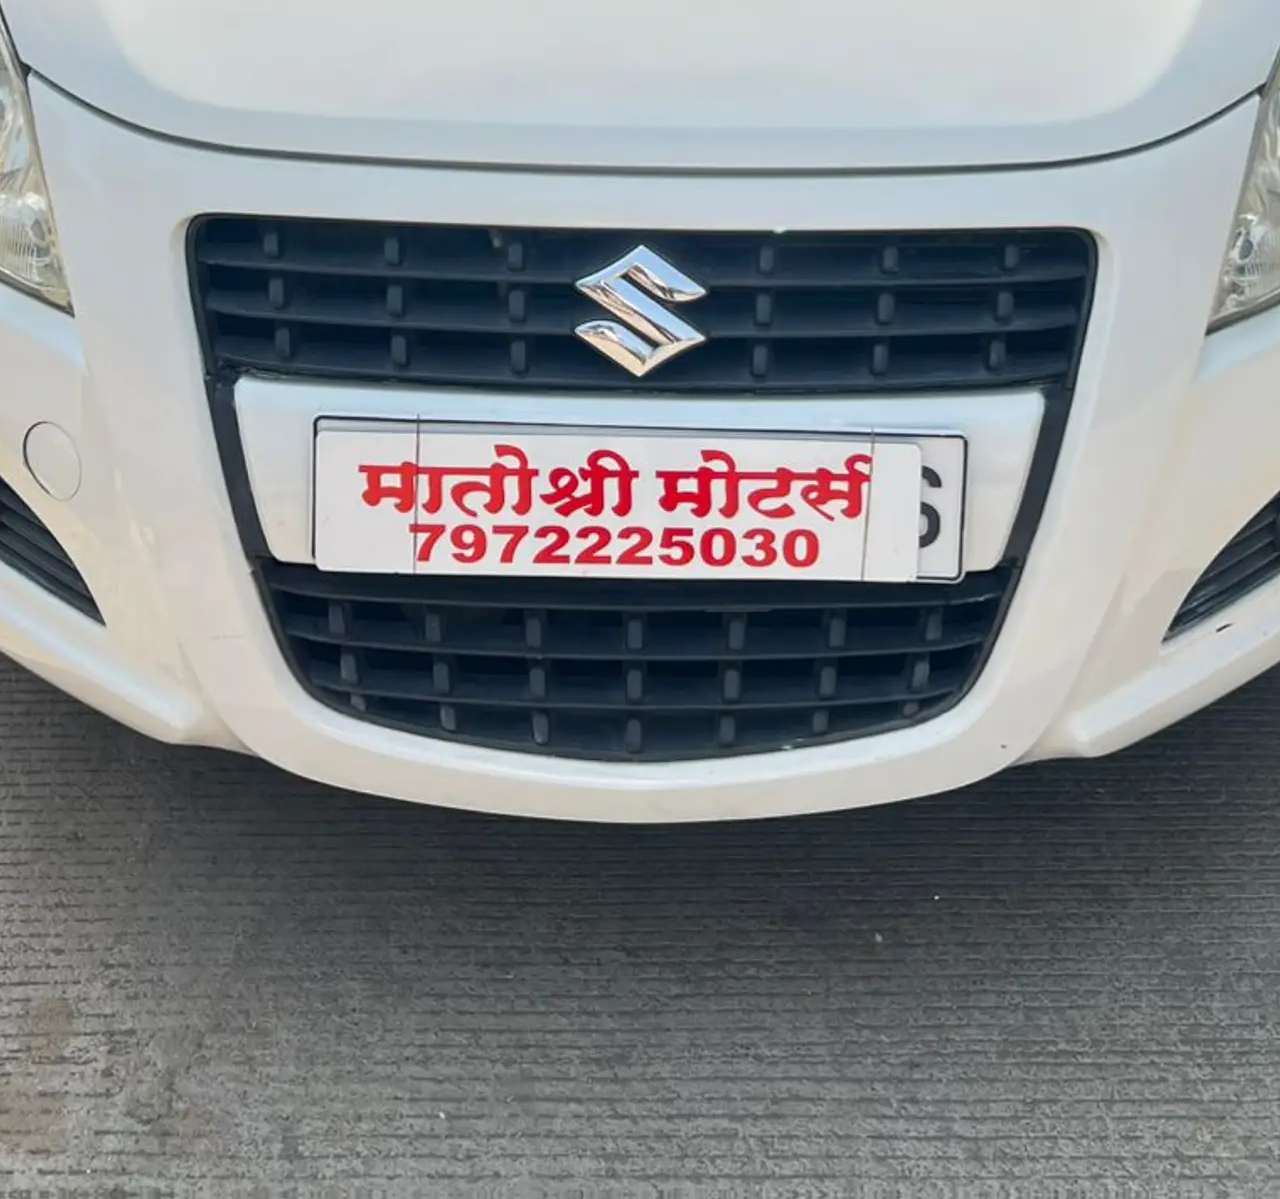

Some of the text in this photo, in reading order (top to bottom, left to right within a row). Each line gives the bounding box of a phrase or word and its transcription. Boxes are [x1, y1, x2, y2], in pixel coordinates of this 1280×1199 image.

[358, 444, 874, 522] मातोश्री मोटर्स
[408, 523, 820, 569] 7972225030
